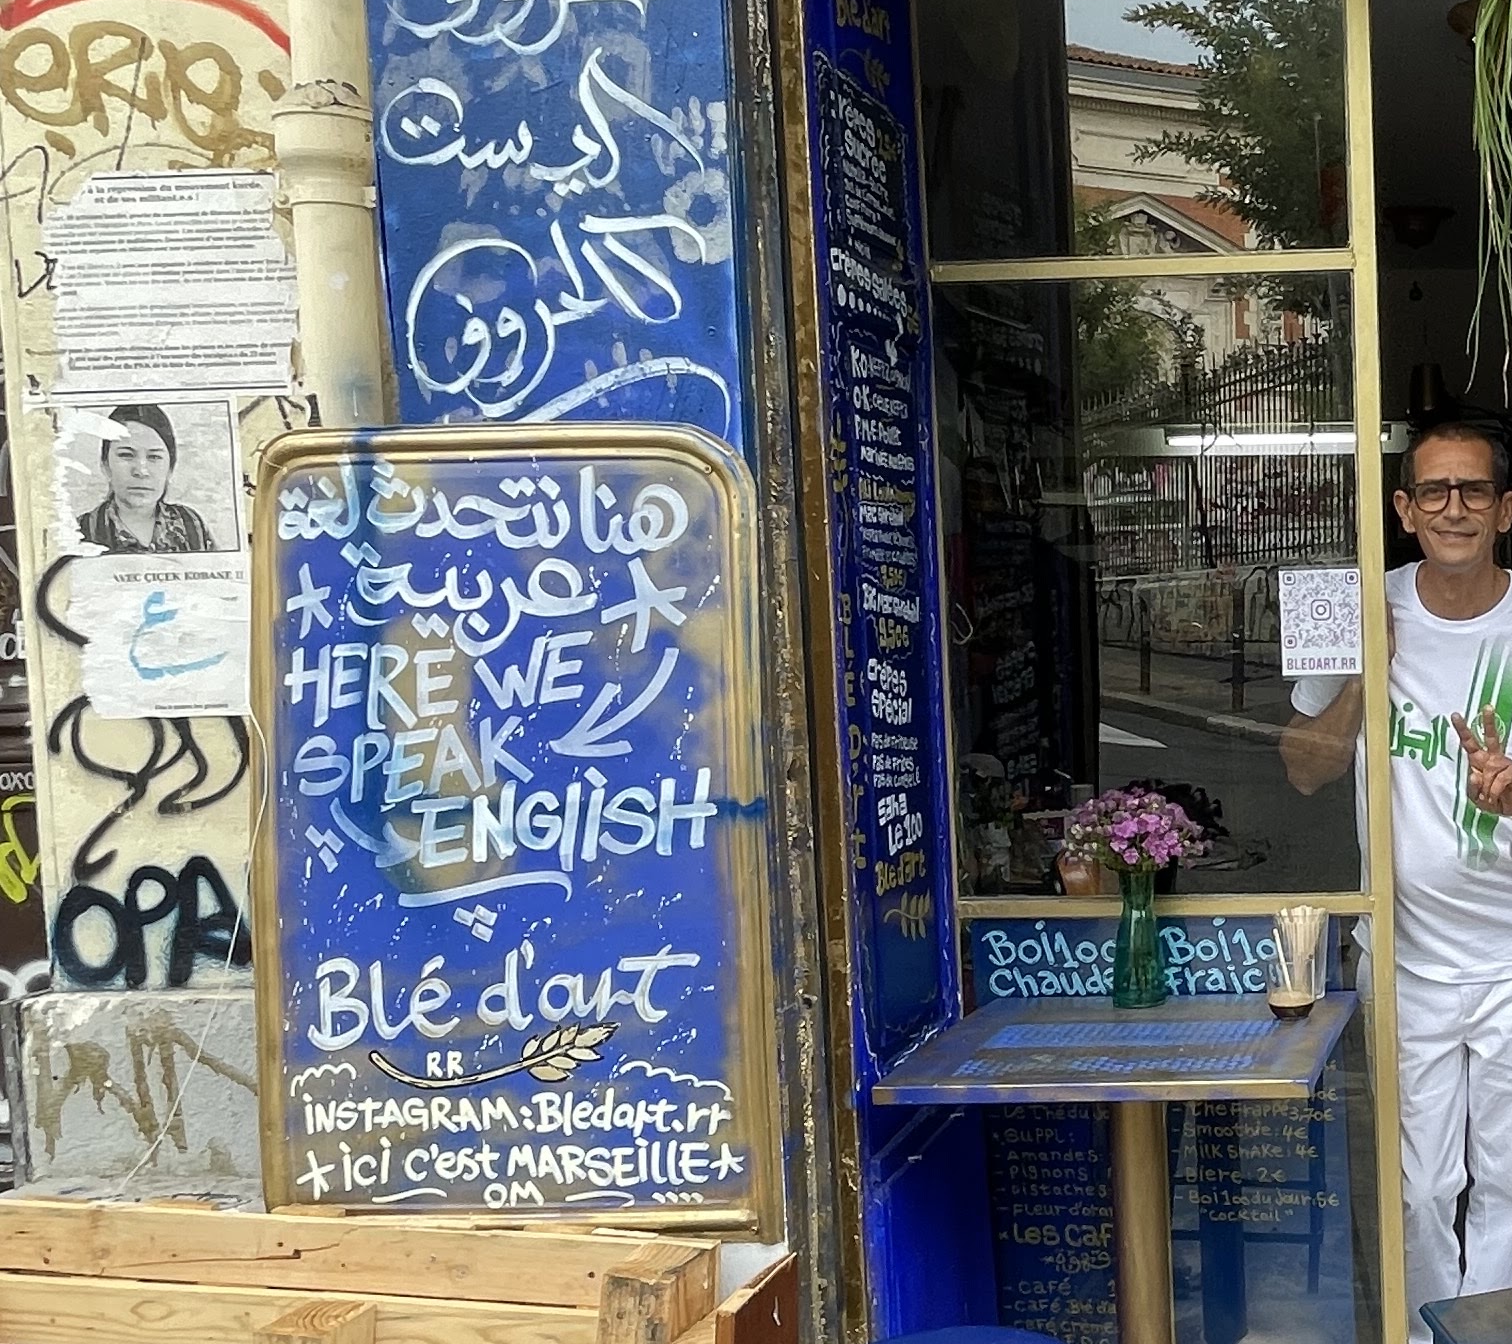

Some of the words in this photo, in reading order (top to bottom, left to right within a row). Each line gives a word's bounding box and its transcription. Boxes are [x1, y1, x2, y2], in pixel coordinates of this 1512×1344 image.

[286, 642, 459, 731] HERE
[475, 628, 594, 712] WE
[1286, 657, 1358, 672] BLEDART.RR
[293, 712, 534, 803] SPEAK
[308, 955, 461, 1052] Blé
[476, 938, 701, 1032] d'art
[339, 1136, 393, 1192] ici
[404, 1138, 501, 1184] c'est
[1013, 1220, 1061, 1246] Les
[1063, 1222, 1114, 1248] Caf
